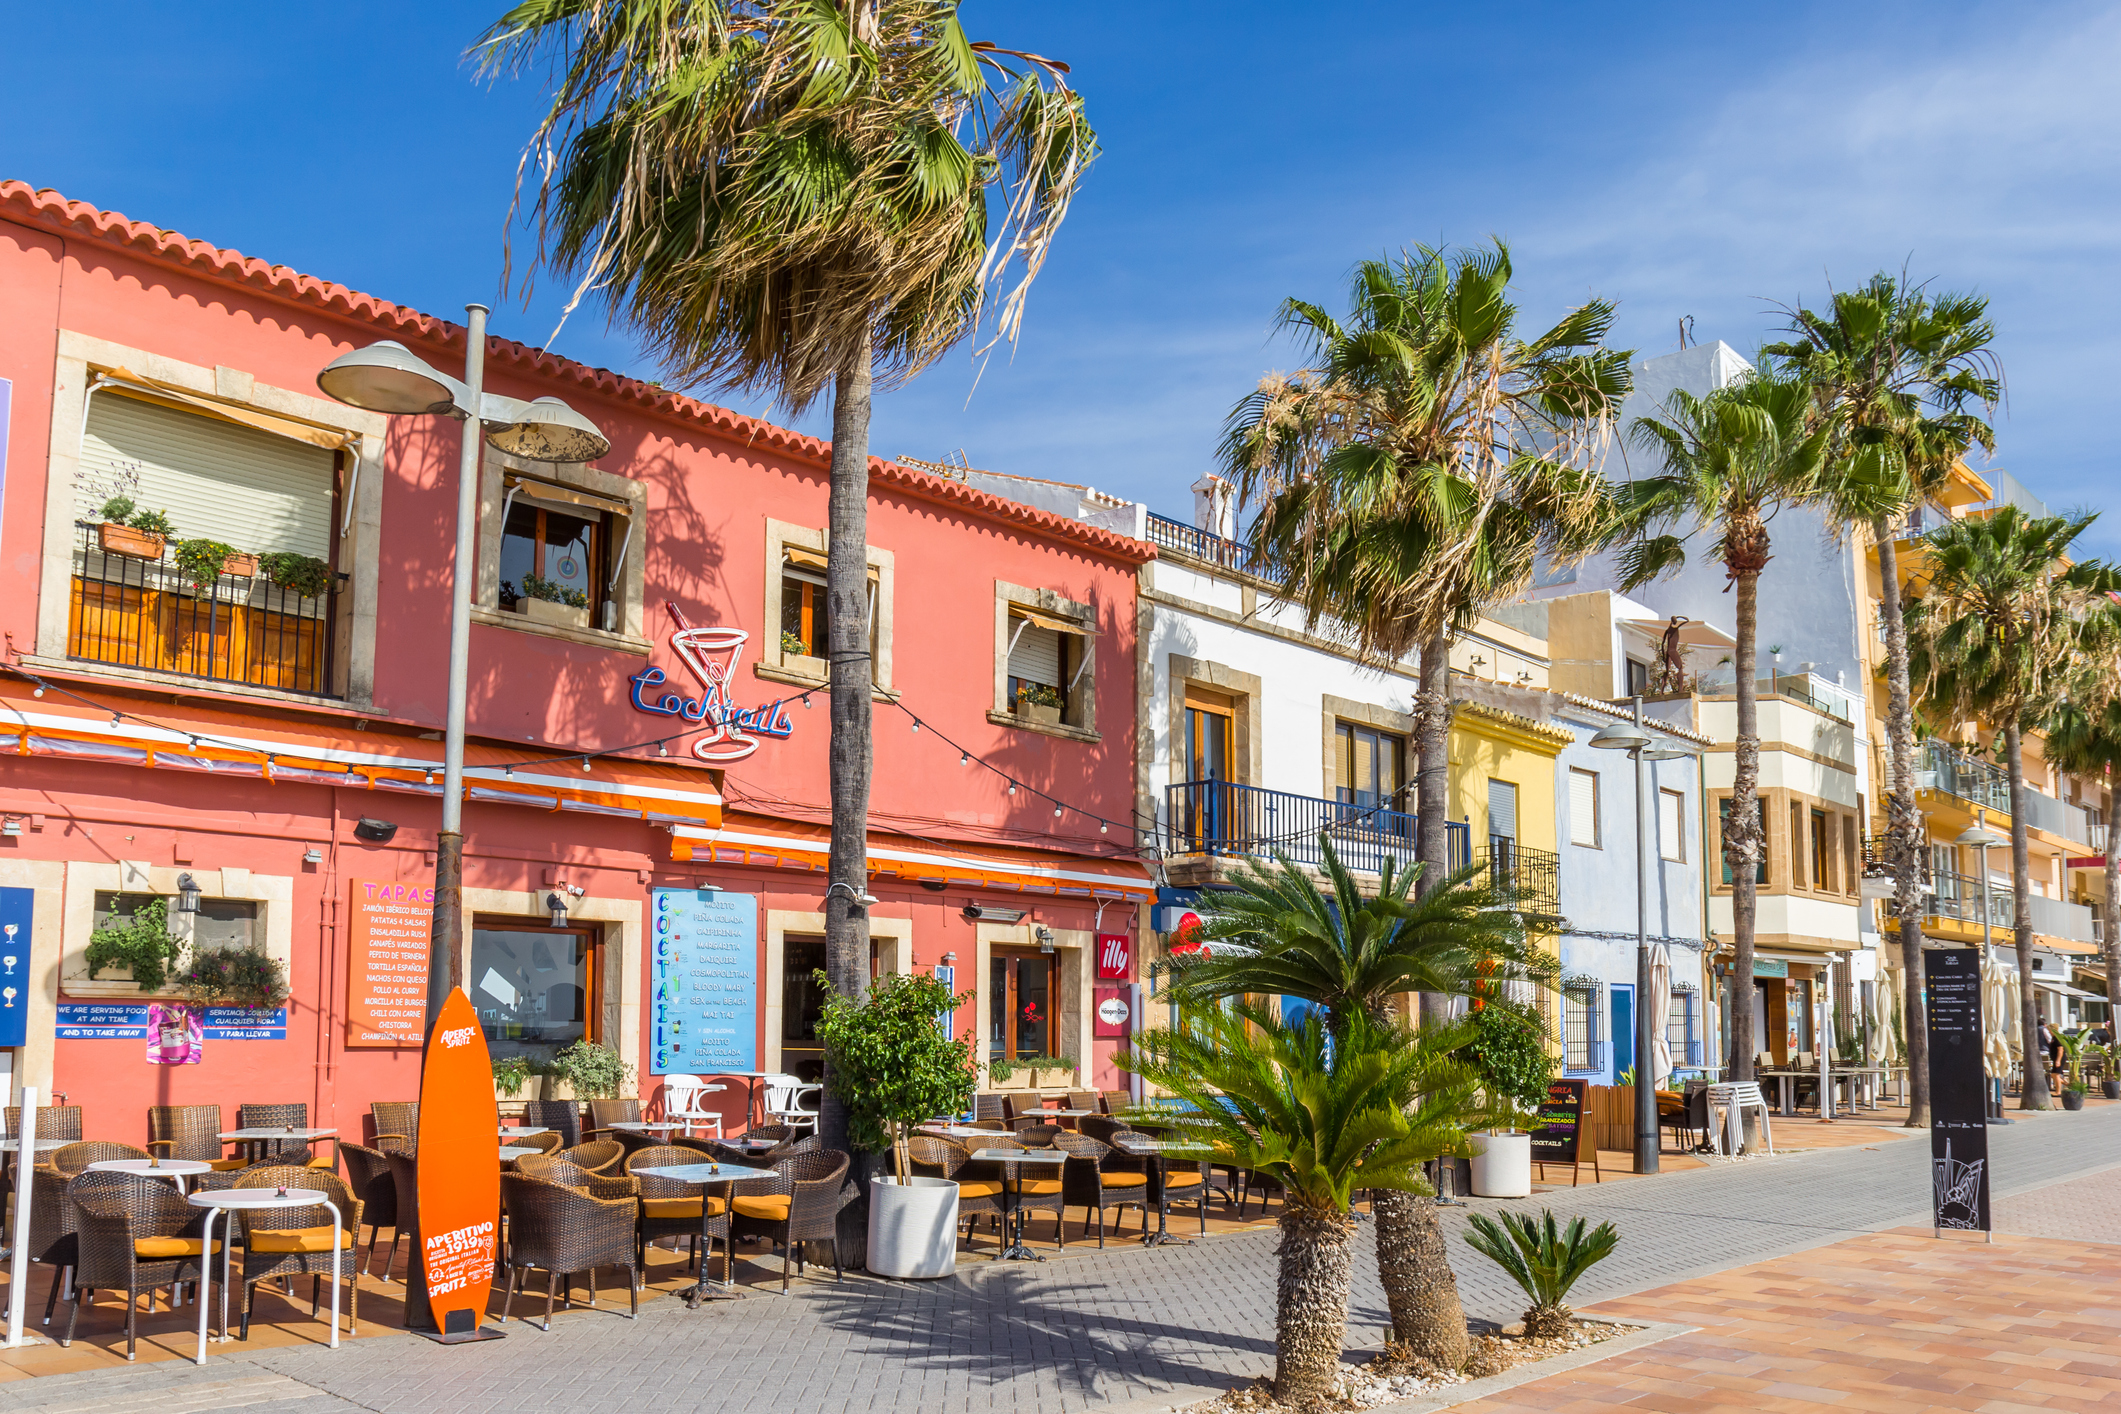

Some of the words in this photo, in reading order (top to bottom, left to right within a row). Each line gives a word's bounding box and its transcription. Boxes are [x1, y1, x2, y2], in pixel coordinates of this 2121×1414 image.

[363, 883, 435, 903] TAPAS
[362, 903, 385, 913] JAMÓN
[385, 904, 410, 914] IBÉRICO
[704, 900, 736, 910] MOJITO
[370, 916, 398, 925] PATATAS
[404, 918, 427, 927] SALSAS
[693, 912, 713, 922] PIÑA
[714, 914, 744, 924] COLADA
[370, 927, 410, 937] ENSALADILLA
[410, 930, 427, 938] RUSA
[696, 927, 742, 938] CAIPIRINHA
[369, 938, 396, 948] CANAPÉS
[397, 941, 427, 950] VARIADOS
[696, 941, 741, 951] MARGARITA
[368, 950, 390, 959] PEPITO
[391, 951, 399, 960] DE
[400, 952, 426, 960] TERNERA
[699, 955, 737, 965] DAIQUIRI
[1102, 939, 1128, 975] illy
[367, 962, 396, 971] TORTILLA
[397, 963, 427, 972] ESPAÑOLA
[690, 968, 750, 979] COSMOPOLITAN
[366, 974, 391, 982] NACHOS
[392, 975, 405, 983] CON
[406, 976, 427, 984] QUESO
[656, 892, 670, 1069] COCTAILS
[372, 986, 392, 994] POLLO
[401, 987, 420, 995] CURRY
[693, 982, 723, 992] BLOODY
[724, 984, 746, 992] MARY
[364, 997, 394, 1005] MORCILLA
[395, 998, 403, 1006] DE
[404, 998, 427, 1007] BURGOS
[690, 996, 706, 1005] SEX
[722, 997, 747, 1006] BEACH
[57, 1006, 71, 1014] WE
[72, 1006, 88, 1014] ARE
[125, 1007, 147, 1015] FOOD
[209, 1009, 246, 1017] SERVIMOS
[370, 1009, 387, 1017] CHILI
[402, 1010, 421, 1018] CARNE
[702, 1010, 718, 1019] MAI
[719, 1011, 735, 1020] TAI
[378, 1021, 412, 1029] CHISTORRA
[361, 1031, 397, 1040] CHAMPIÑÓN
[398, 1033, 406, 1041] AL
[440, 1026, 476, 1043] APEROL
[446, 1036, 470, 1048] SPRITZ
[701, 1038, 730, 1046] MOJITO
[695, 1047, 713, 1056] PIÑA
[714, 1048, 741, 1057] COLADA
[689, 1059, 705, 1067] SAN
[706, 1058, 745, 1067] FRANCISCO
[1547, 1086, 1572, 1094] NGRIA
[1530, 1139, 1562, 1147] COCKTAILS
[426, 1221, 493, 1250] APERITIVO
[446, 1236, 478, 1254] 1919
[428, 1276, 467, 1298] SPRITZ
